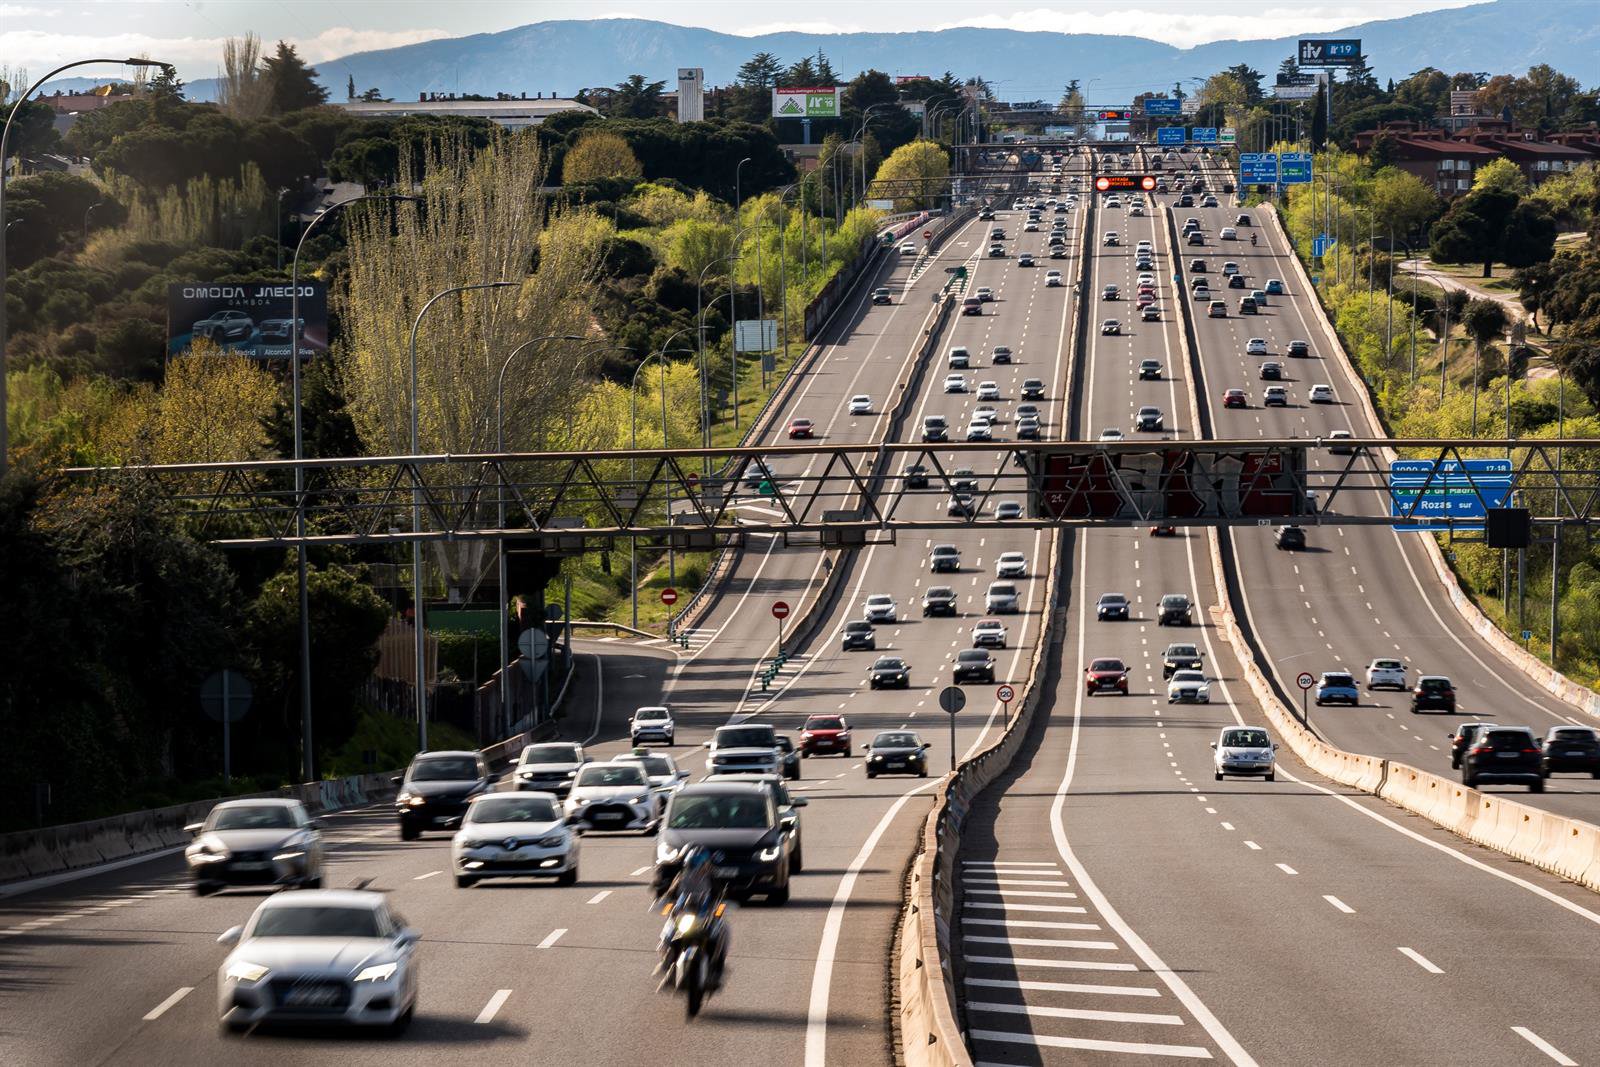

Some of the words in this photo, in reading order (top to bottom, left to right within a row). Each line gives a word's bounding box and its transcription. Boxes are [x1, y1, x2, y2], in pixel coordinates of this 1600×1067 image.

[1302, 42, 1322, 58] itv
[1340, 45, 1352, 54] 19
[183, 287, 245, 298] OMODA
[1421, 500, 1452, 509] Rozas
